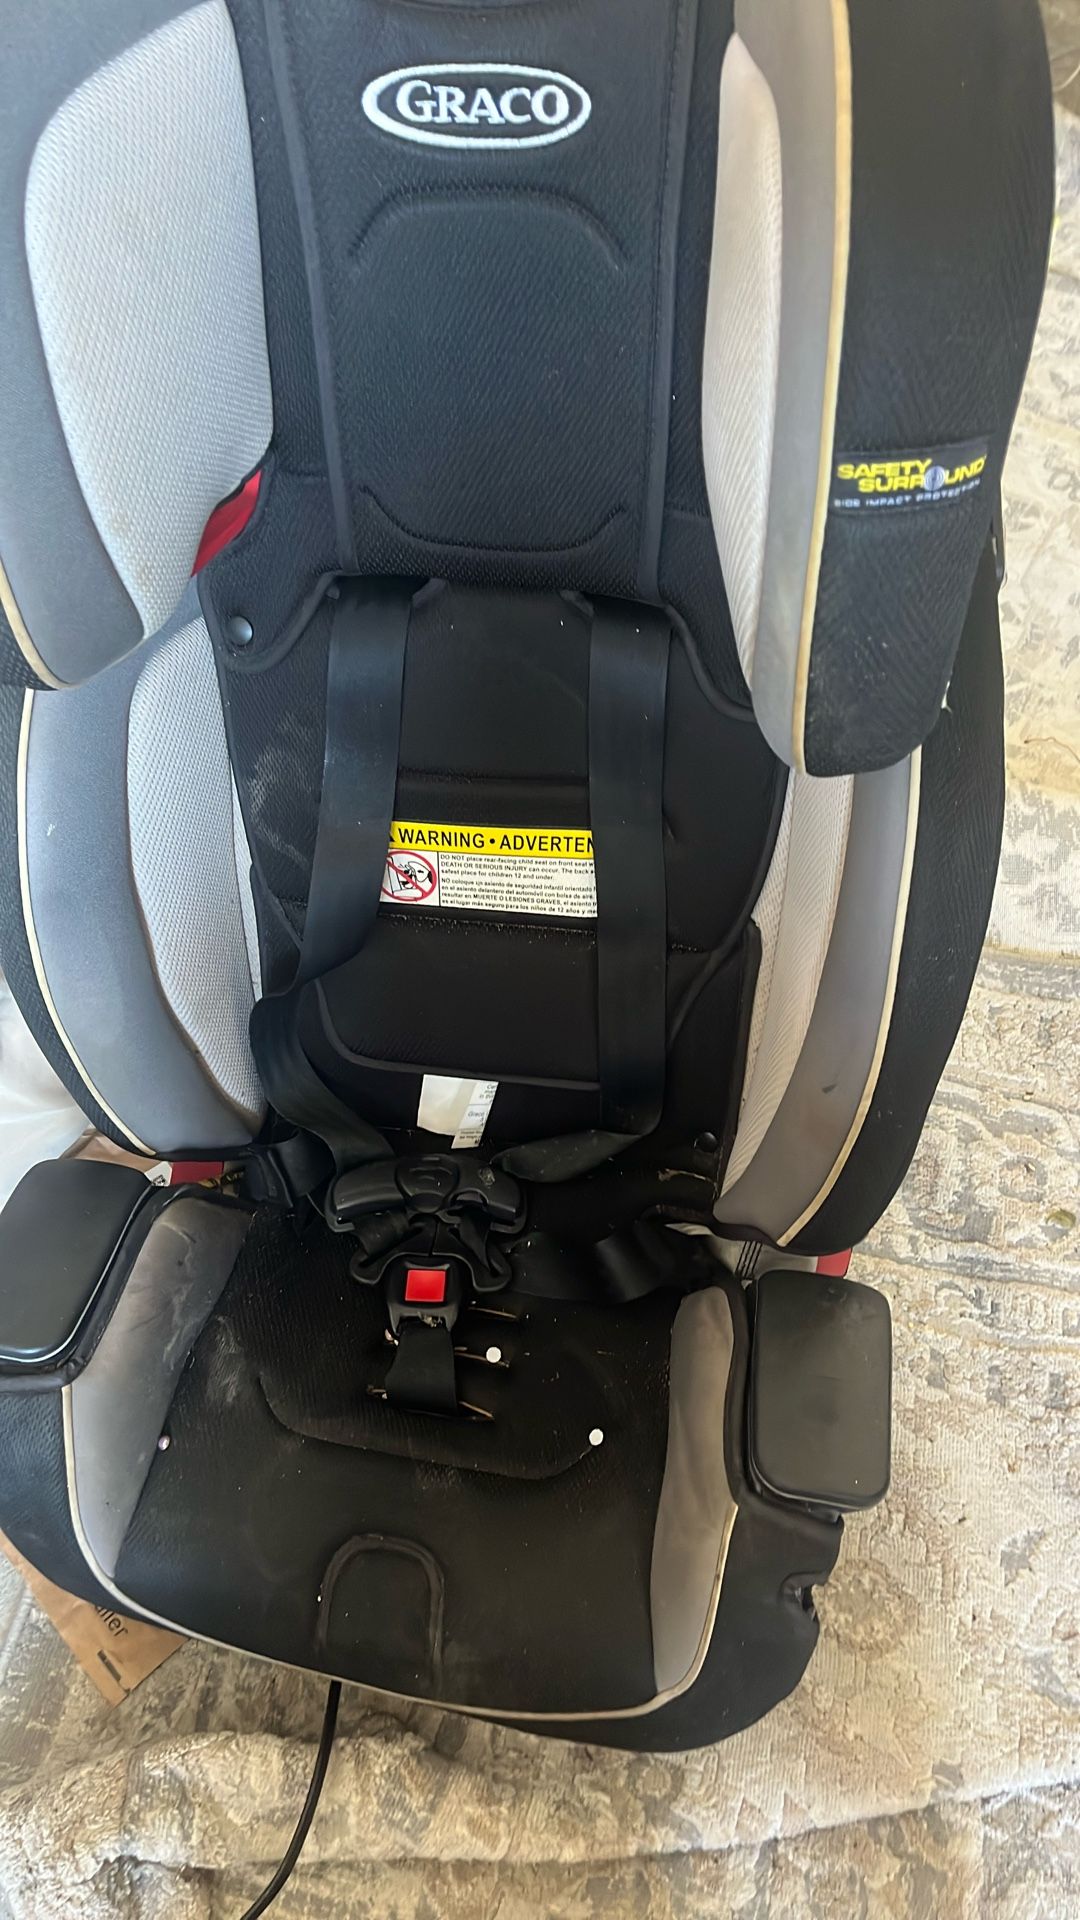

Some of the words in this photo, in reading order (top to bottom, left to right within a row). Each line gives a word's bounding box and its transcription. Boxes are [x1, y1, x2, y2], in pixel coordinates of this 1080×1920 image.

[396, 79, 569, 125] GRACO
[837, 459, 932, 479] SAFETY
[865, 494, 912, 507] IMPACT
[398, 827, 485, 849] WARNING
